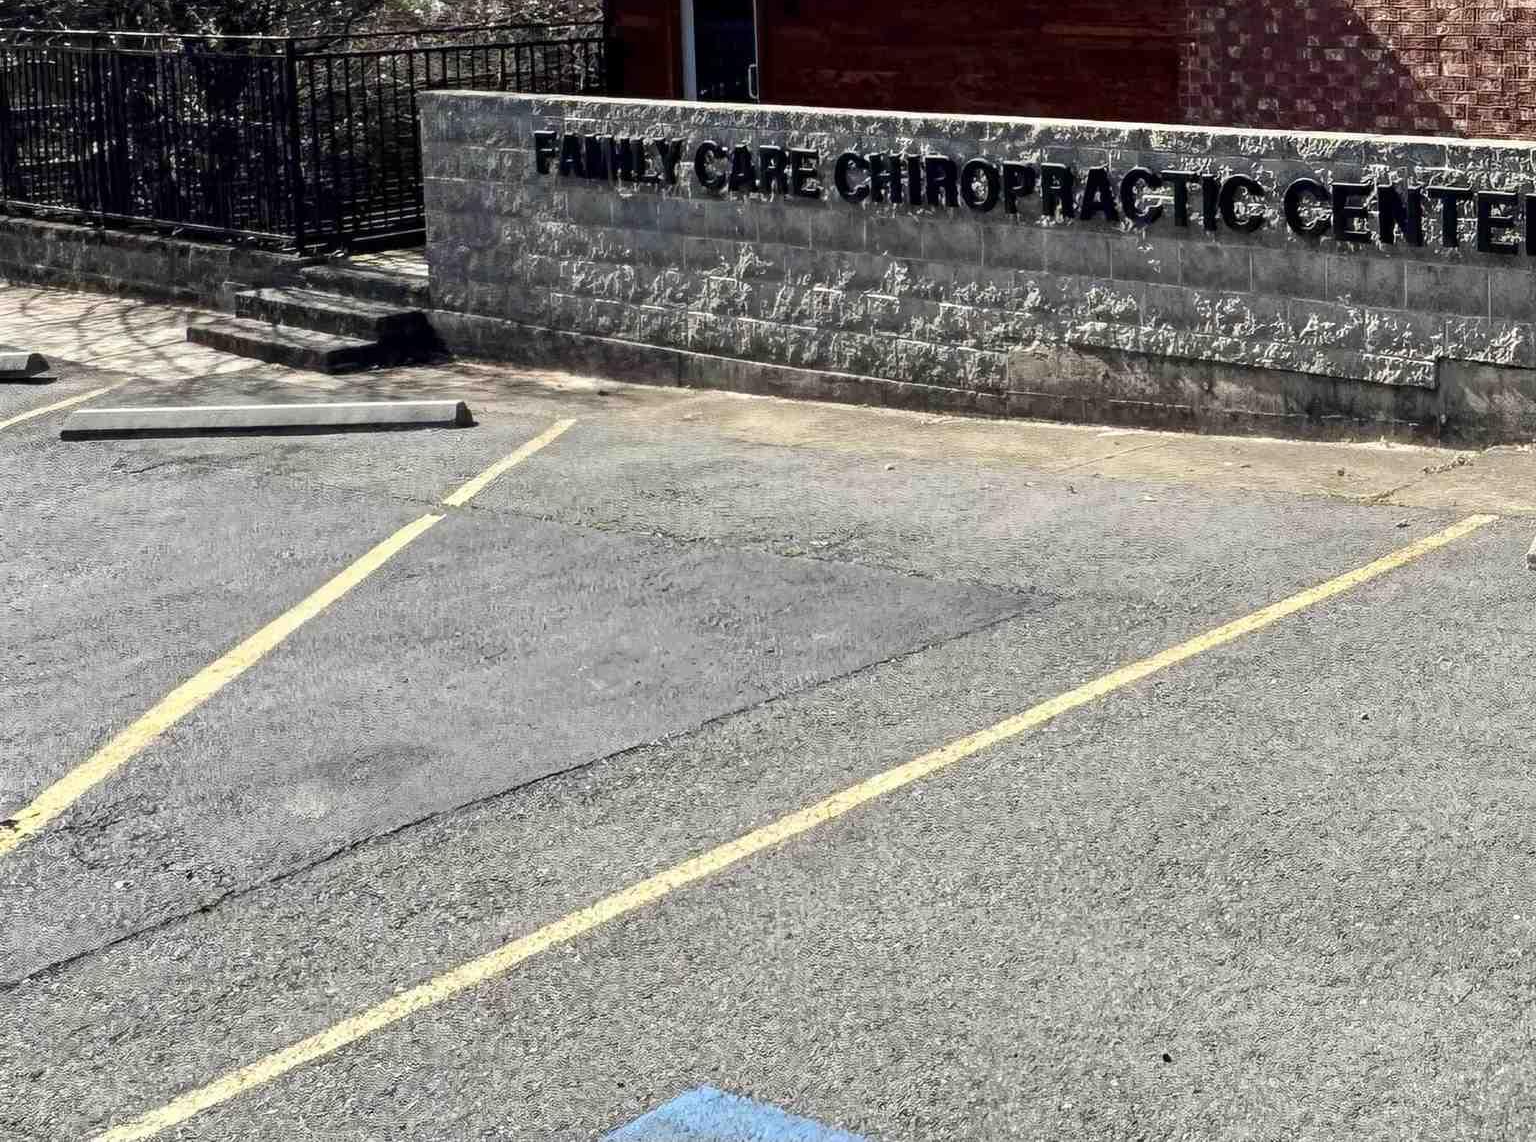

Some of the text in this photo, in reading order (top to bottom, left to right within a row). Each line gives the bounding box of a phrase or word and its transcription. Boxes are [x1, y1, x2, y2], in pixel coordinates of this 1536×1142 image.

[534, 130, 685, 186] FAMILY
[694, 139, 823, 201] CARE
[834, 152, 1266, 235] CHIROPRACTIC
